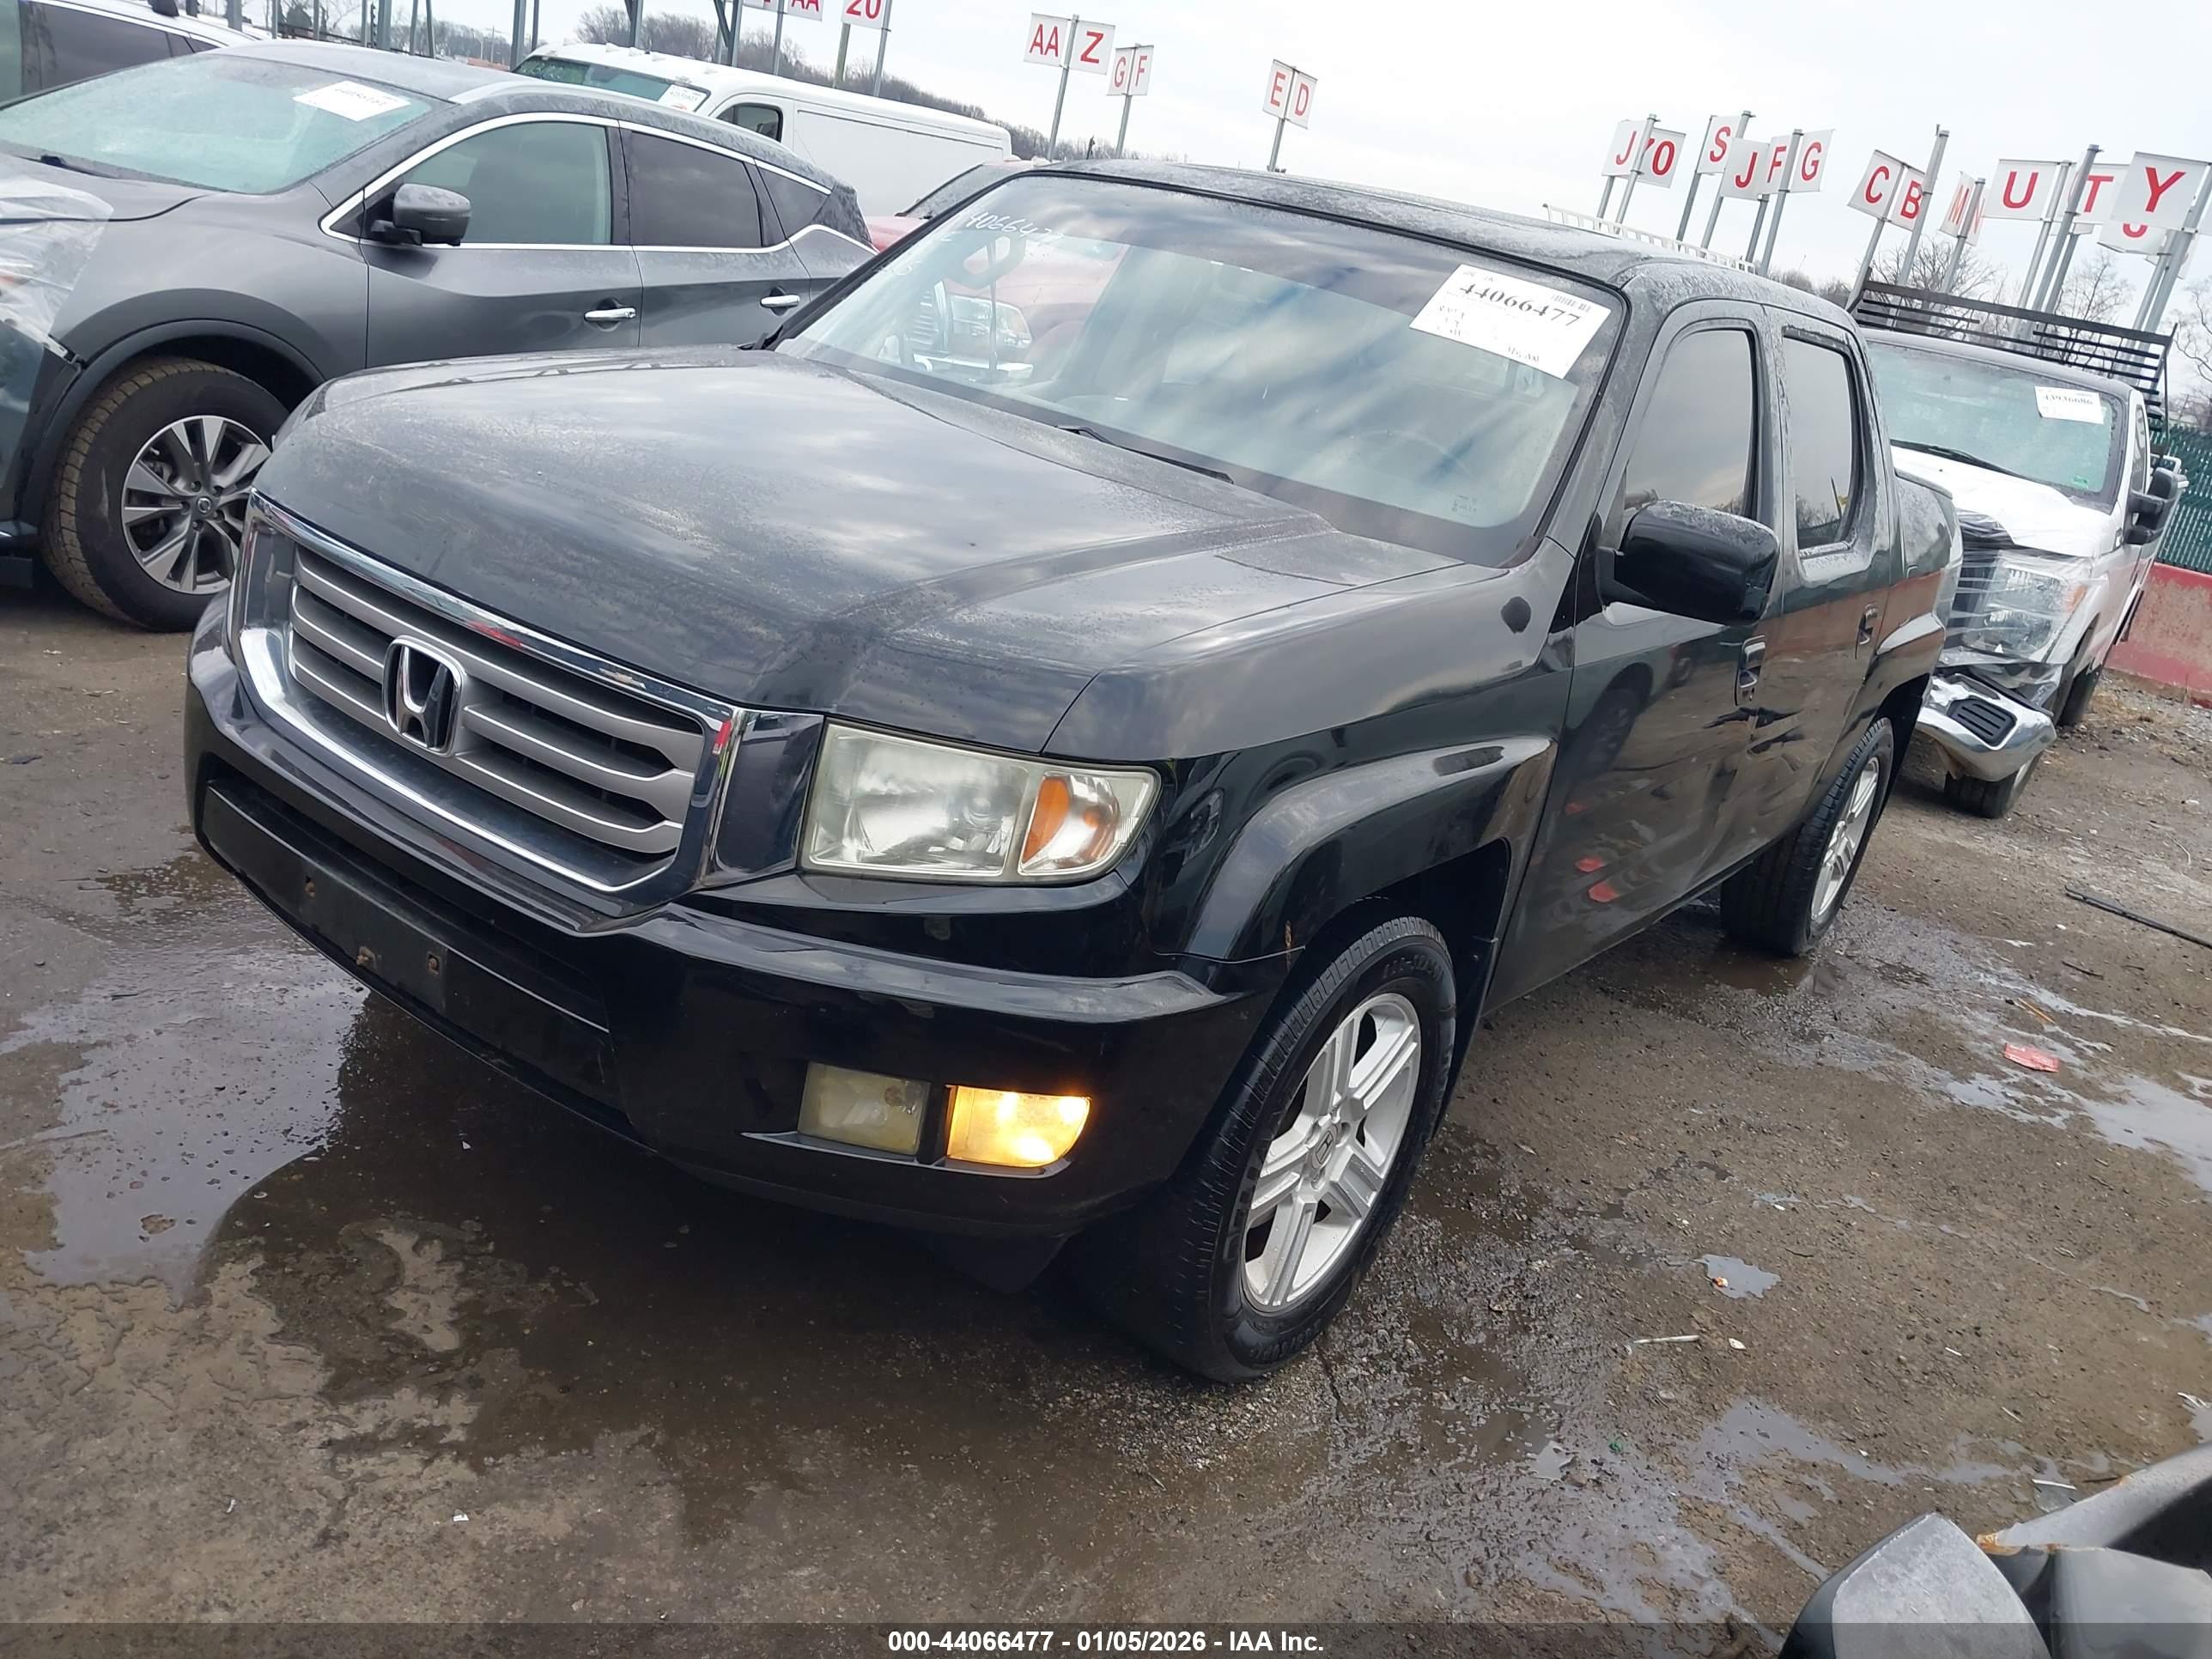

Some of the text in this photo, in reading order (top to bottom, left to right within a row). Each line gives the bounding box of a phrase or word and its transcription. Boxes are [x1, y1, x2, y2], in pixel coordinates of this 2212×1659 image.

[1029, 24, 1059, 58] AA
[1080, 31, 1104, 64] Z
[1114, 57, 1126, 88] G
[1136, 55, 1147, 87] F
[1270, 71, 1286, 106] E
[1295, 83, 1310, 116] D
[1616, 131, 1637, 165] J
[1652, 141, 1675, 175] O
[1710, 126, 1731, 162] S
[1802, 142, 1822, 181] G
[1735, 151, 1758, 188] J
[1767, 146, 1787, 183] F
[1865, 166, 1889, 204] C
[1900, 180, 1922, 219] B
[2002, 172, 2039, 209] U
[2084, 175, 2114, 213] T
[2145, 167, 2186, 213] Y
[1460, 283, 1581, 326] 44066477
